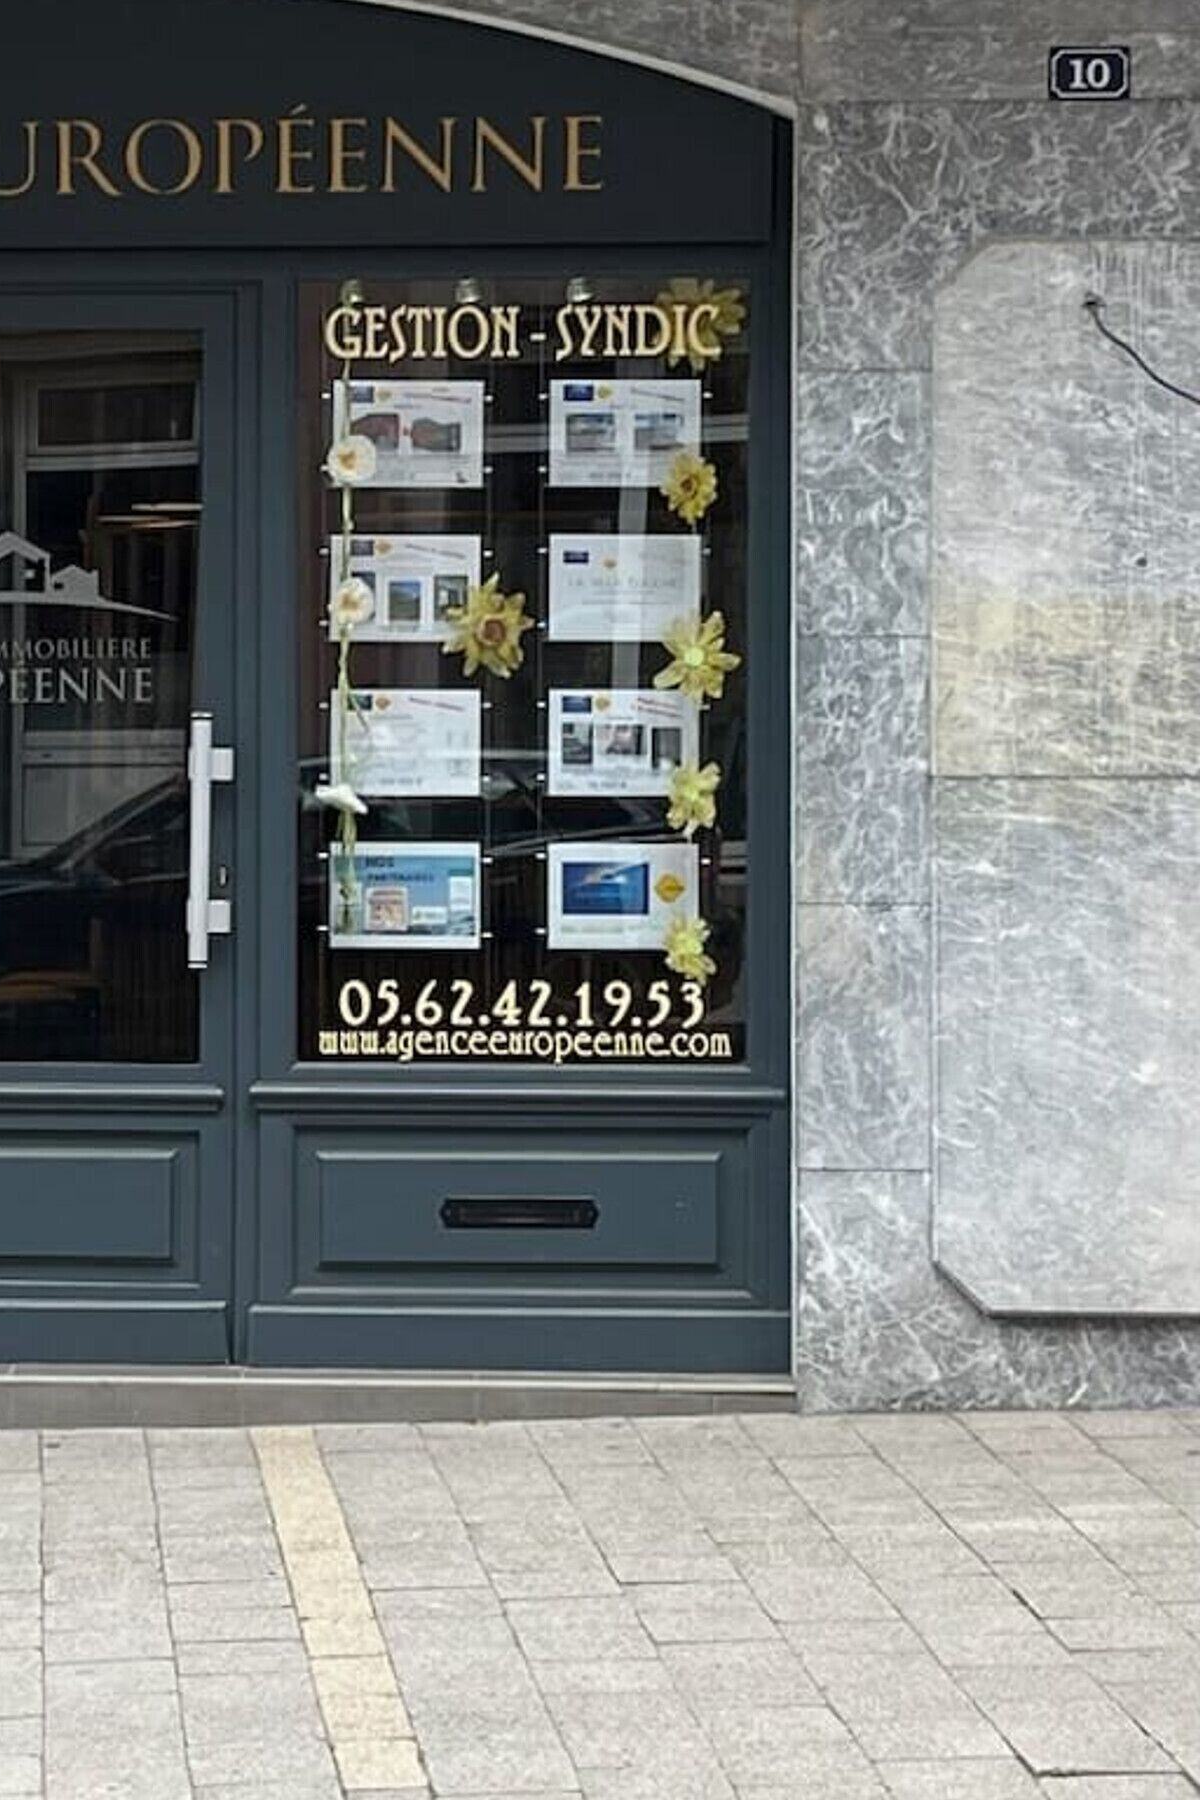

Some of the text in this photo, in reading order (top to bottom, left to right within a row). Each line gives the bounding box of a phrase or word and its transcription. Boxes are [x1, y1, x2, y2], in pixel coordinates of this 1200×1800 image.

[1069, 58, 1110, 89] 10
[325, 303, 520, 363] GESTION
[555, 303, 722, 361] SYNDIC
[338, 977, 705, 1028] 05.62.42.19.53
[318, 1028, 732, 1062] www.agenceeuropeenne.com
